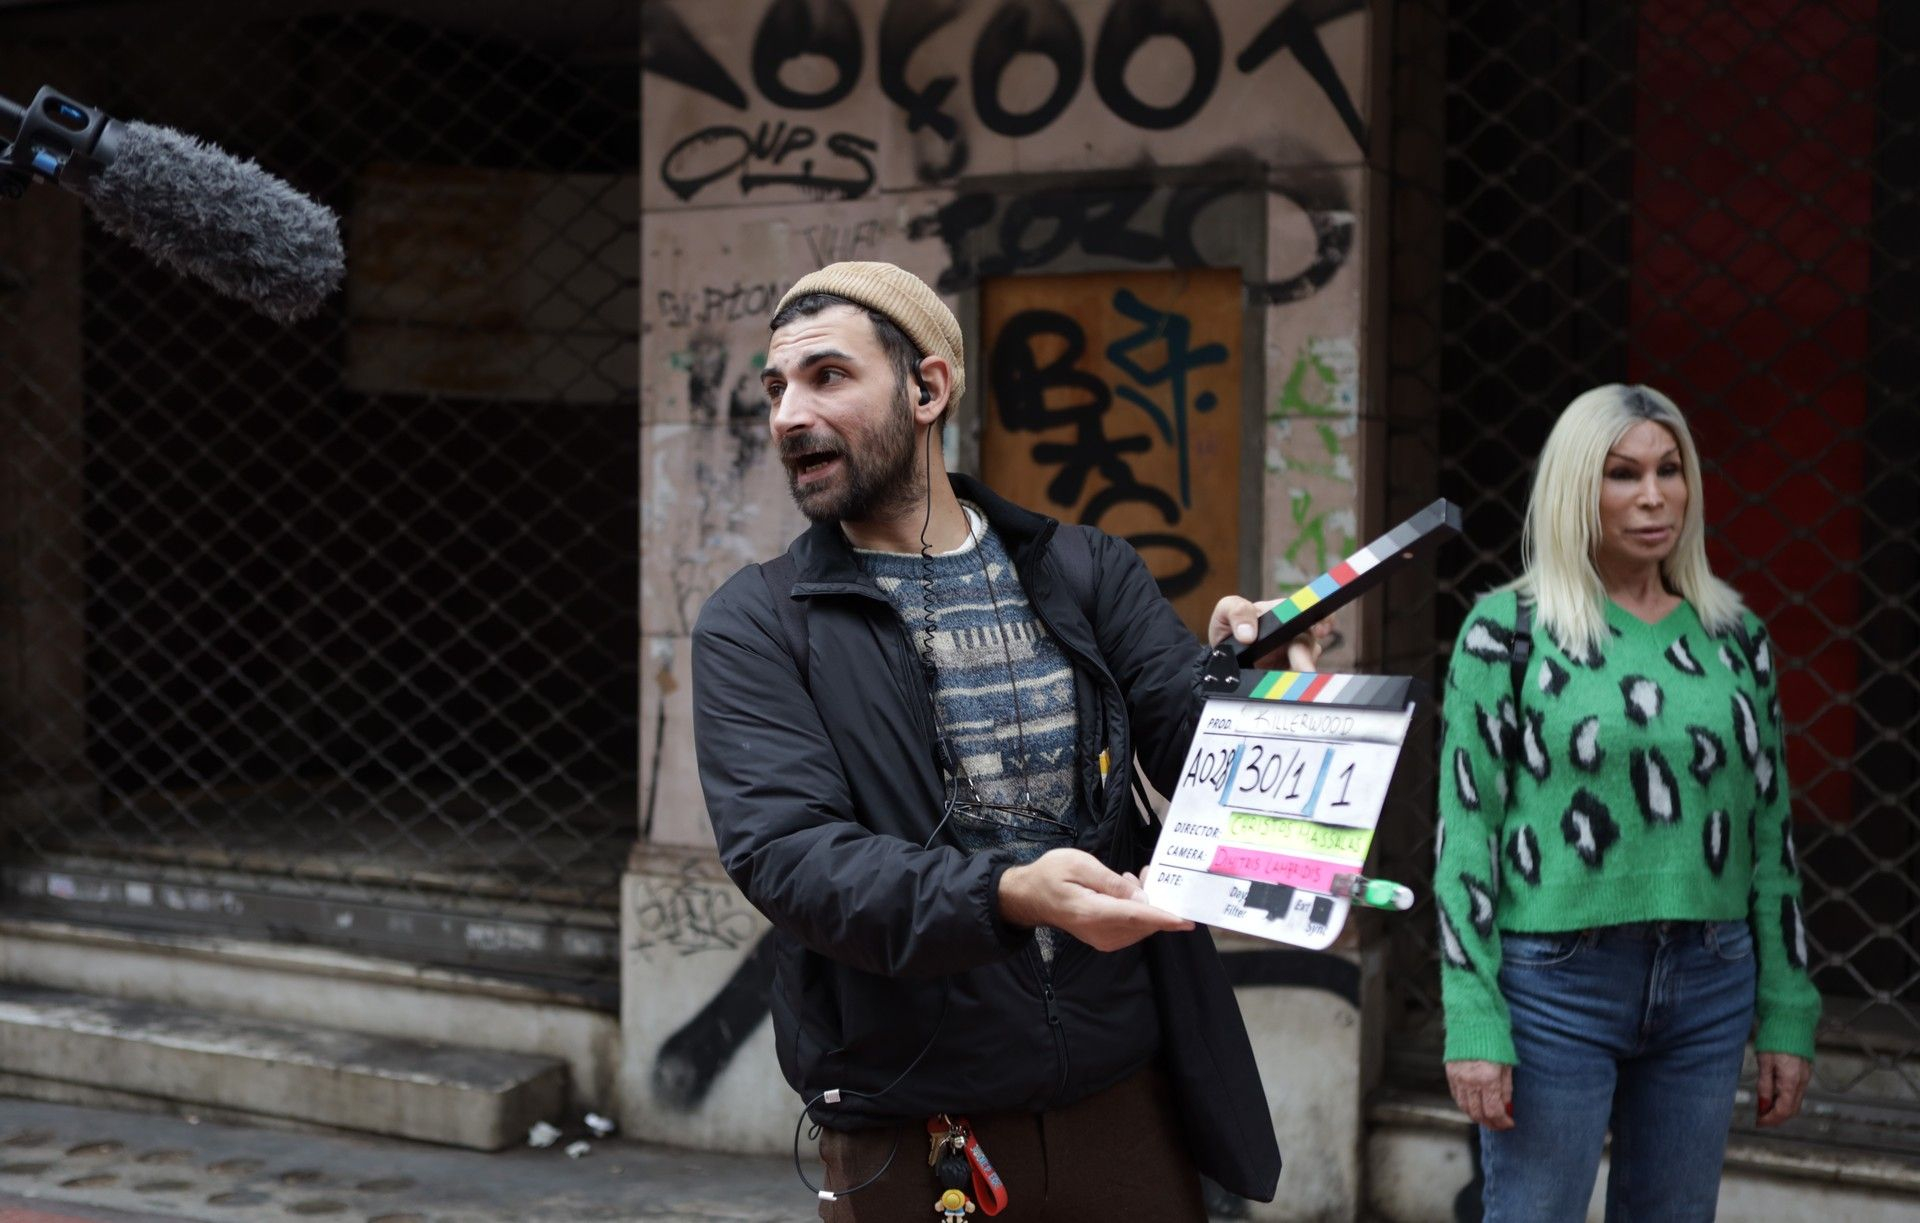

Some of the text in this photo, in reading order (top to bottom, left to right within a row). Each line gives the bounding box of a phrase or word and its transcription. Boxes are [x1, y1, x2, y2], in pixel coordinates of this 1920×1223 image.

[1183, 747, 1236, 792] A028
[1239, 744, 1306, 800] 30/1
[1331, 762, 1355, 807] 1
[1174, 821, 1221, 838] DIRECTOR:
[1166, 844, 1207, 861] CAMERA:
[1157, 872, 1184, 886] DATE:
